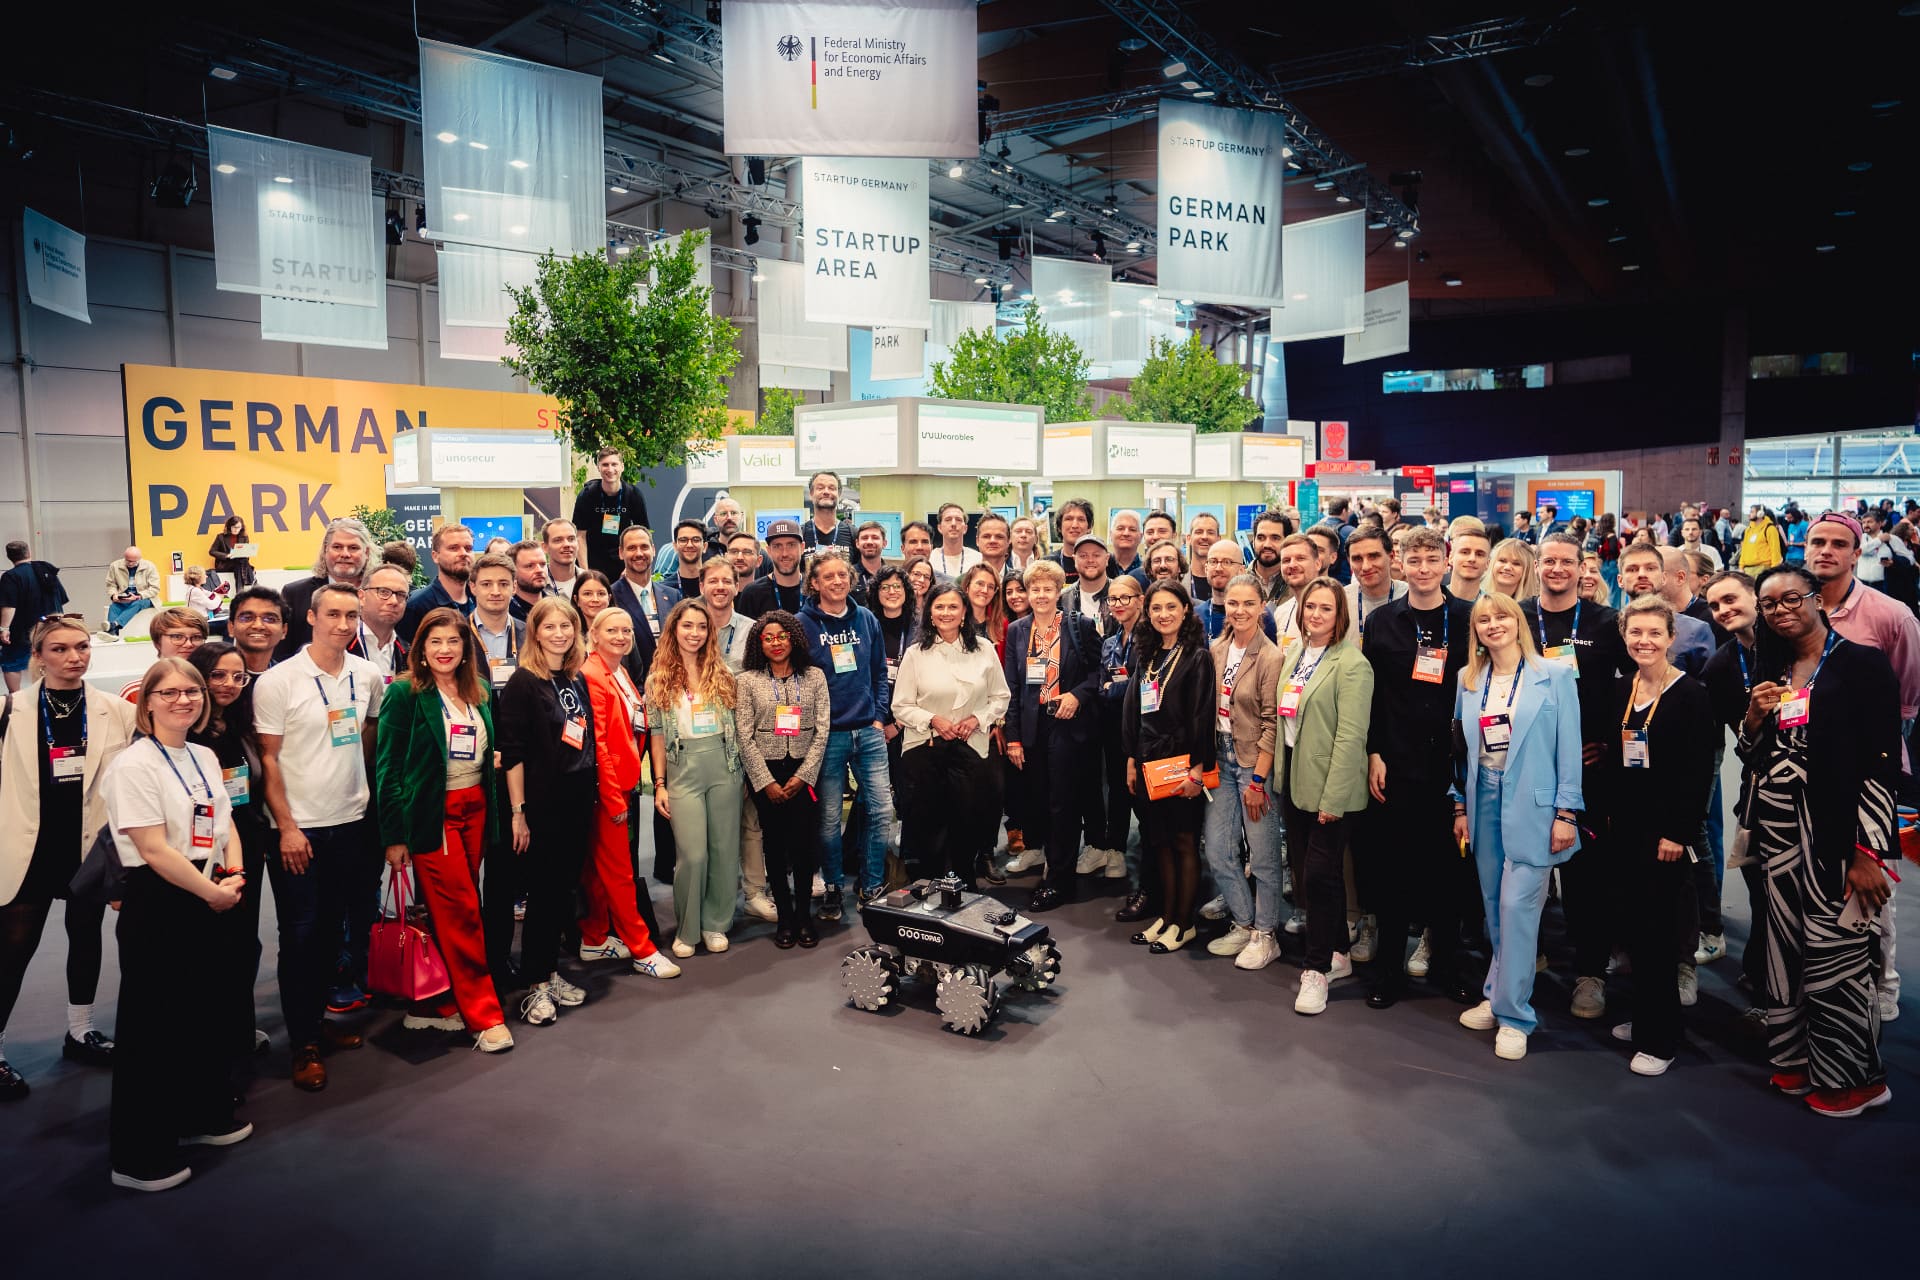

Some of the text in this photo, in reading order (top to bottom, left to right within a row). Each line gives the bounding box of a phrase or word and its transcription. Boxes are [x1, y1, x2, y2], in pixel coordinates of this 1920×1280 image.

[824, 36, 906, 52] Federal Ministry
[824, 51, 927, 66] for Economic Affairs
[824, 66, 882, 81] and Energy
[1169, 136, 1265, 157] STARTUP GERMANY
[814, 172, 909, 192] STARTUP GERMANY
[1169, 196, 1265, 225] GERMAN
[816, 228, 921, 255] STARTUP
[1169, 227, 1229, 252] PARK
[272, 258, 377, 285] STARTUP
[816, 257, 878, 280] AREA
[875, 335, 900, 349] PARK
[148, 483, 334, 537] PARK
[920, 933, 941, 943] TOPAS
